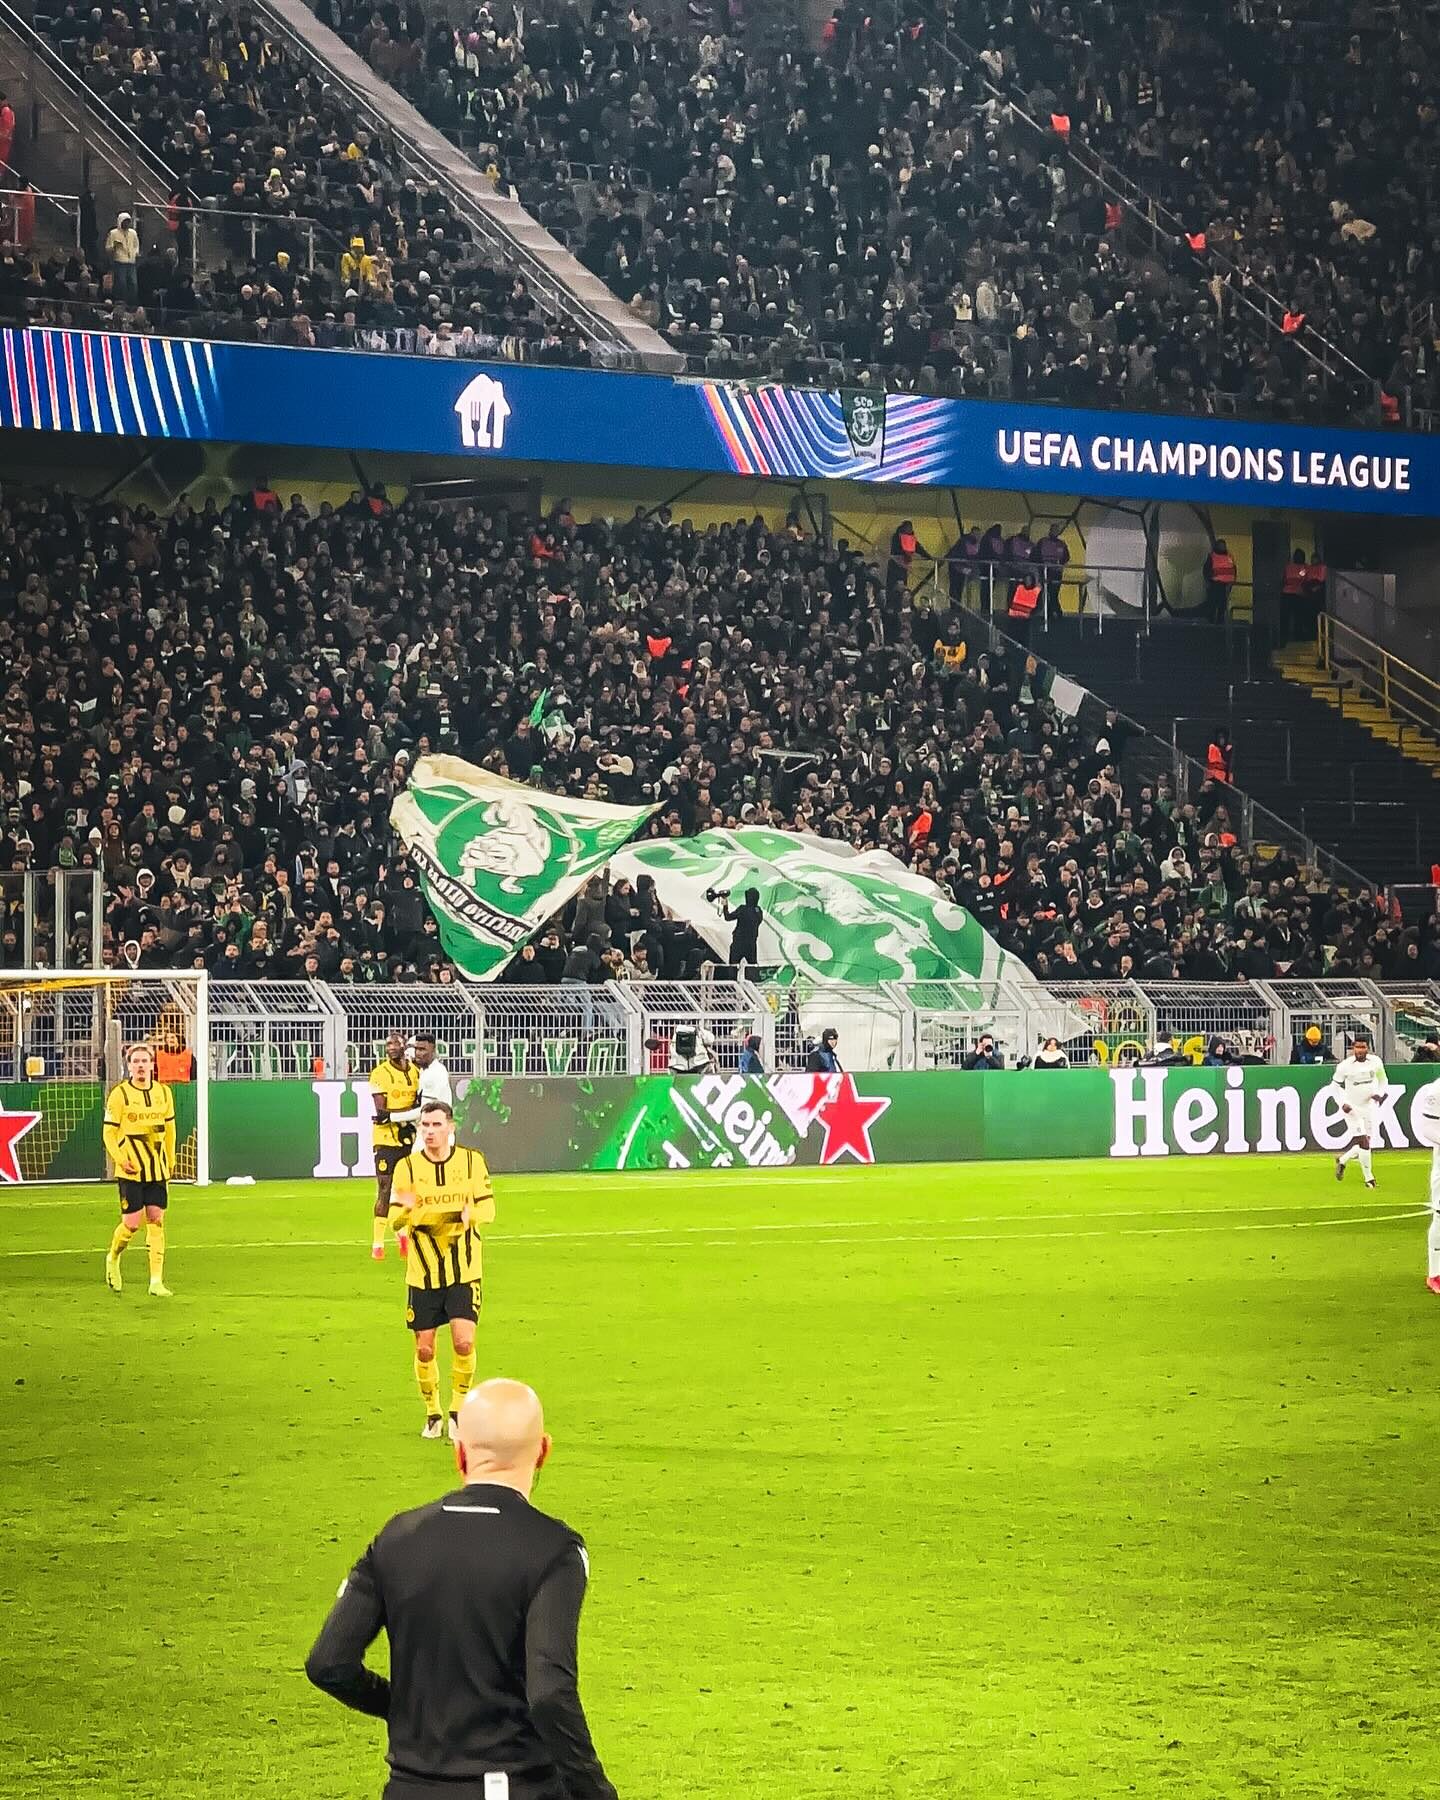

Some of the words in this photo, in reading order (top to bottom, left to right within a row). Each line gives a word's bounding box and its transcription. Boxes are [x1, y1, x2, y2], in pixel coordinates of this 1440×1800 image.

[998, 429, 1082, 468] UEFA
[1091, 435, 1284, 482] CHAMPIONS
[1292, 450, 1411, 490] LEAGUE
